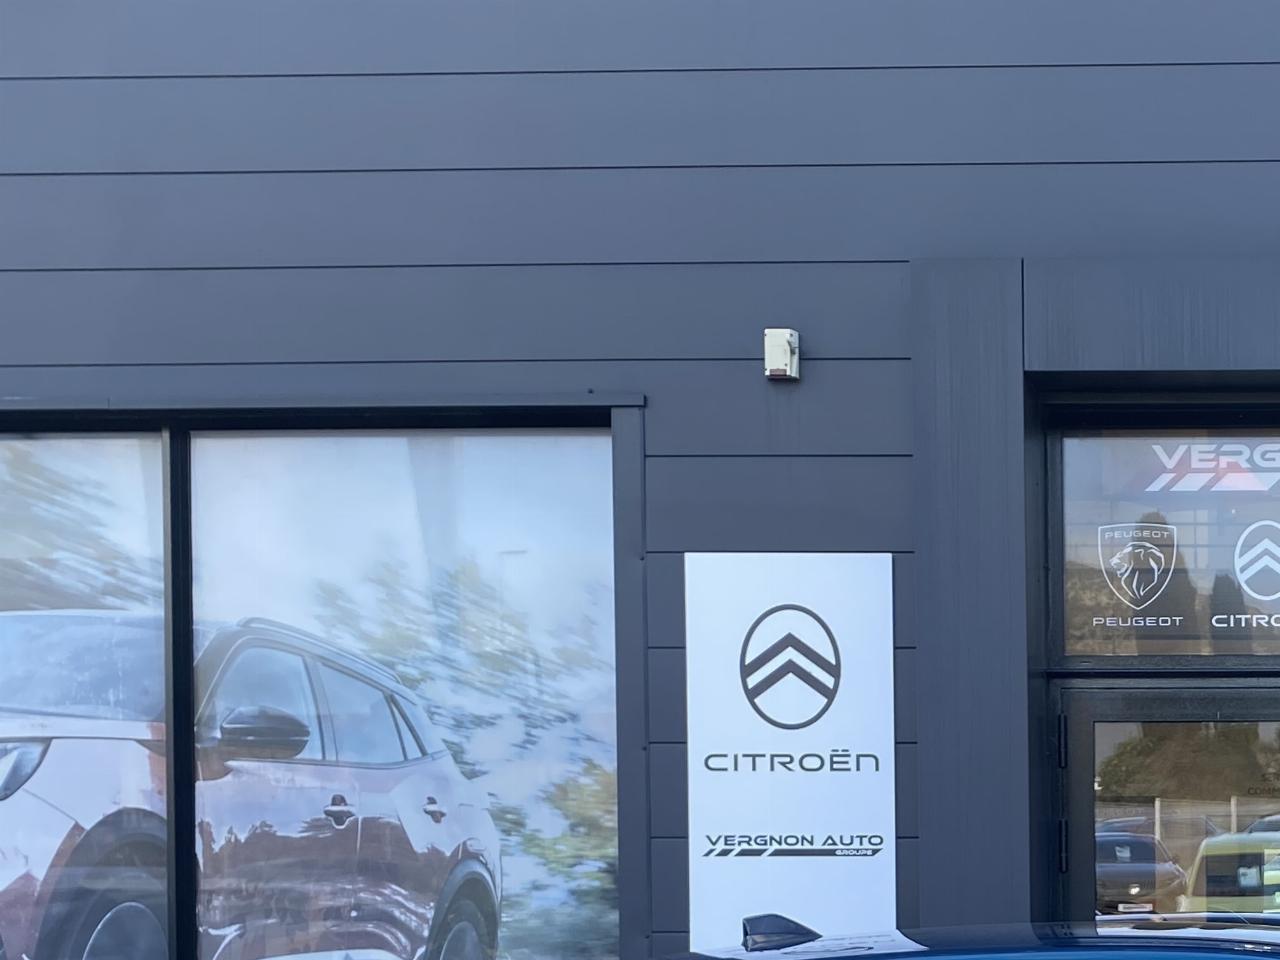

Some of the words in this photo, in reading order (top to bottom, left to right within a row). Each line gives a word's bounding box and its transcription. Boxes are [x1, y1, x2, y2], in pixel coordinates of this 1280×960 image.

[1104, 530, 1170, 539] PEUGEOT
[1092, 616, 1184, 627] PEUGEOT
[704, 749, 880, 772] CITROËN
[705, 834, 814, 846] VERGNON
[821, 834, 884, 846] AUTO
